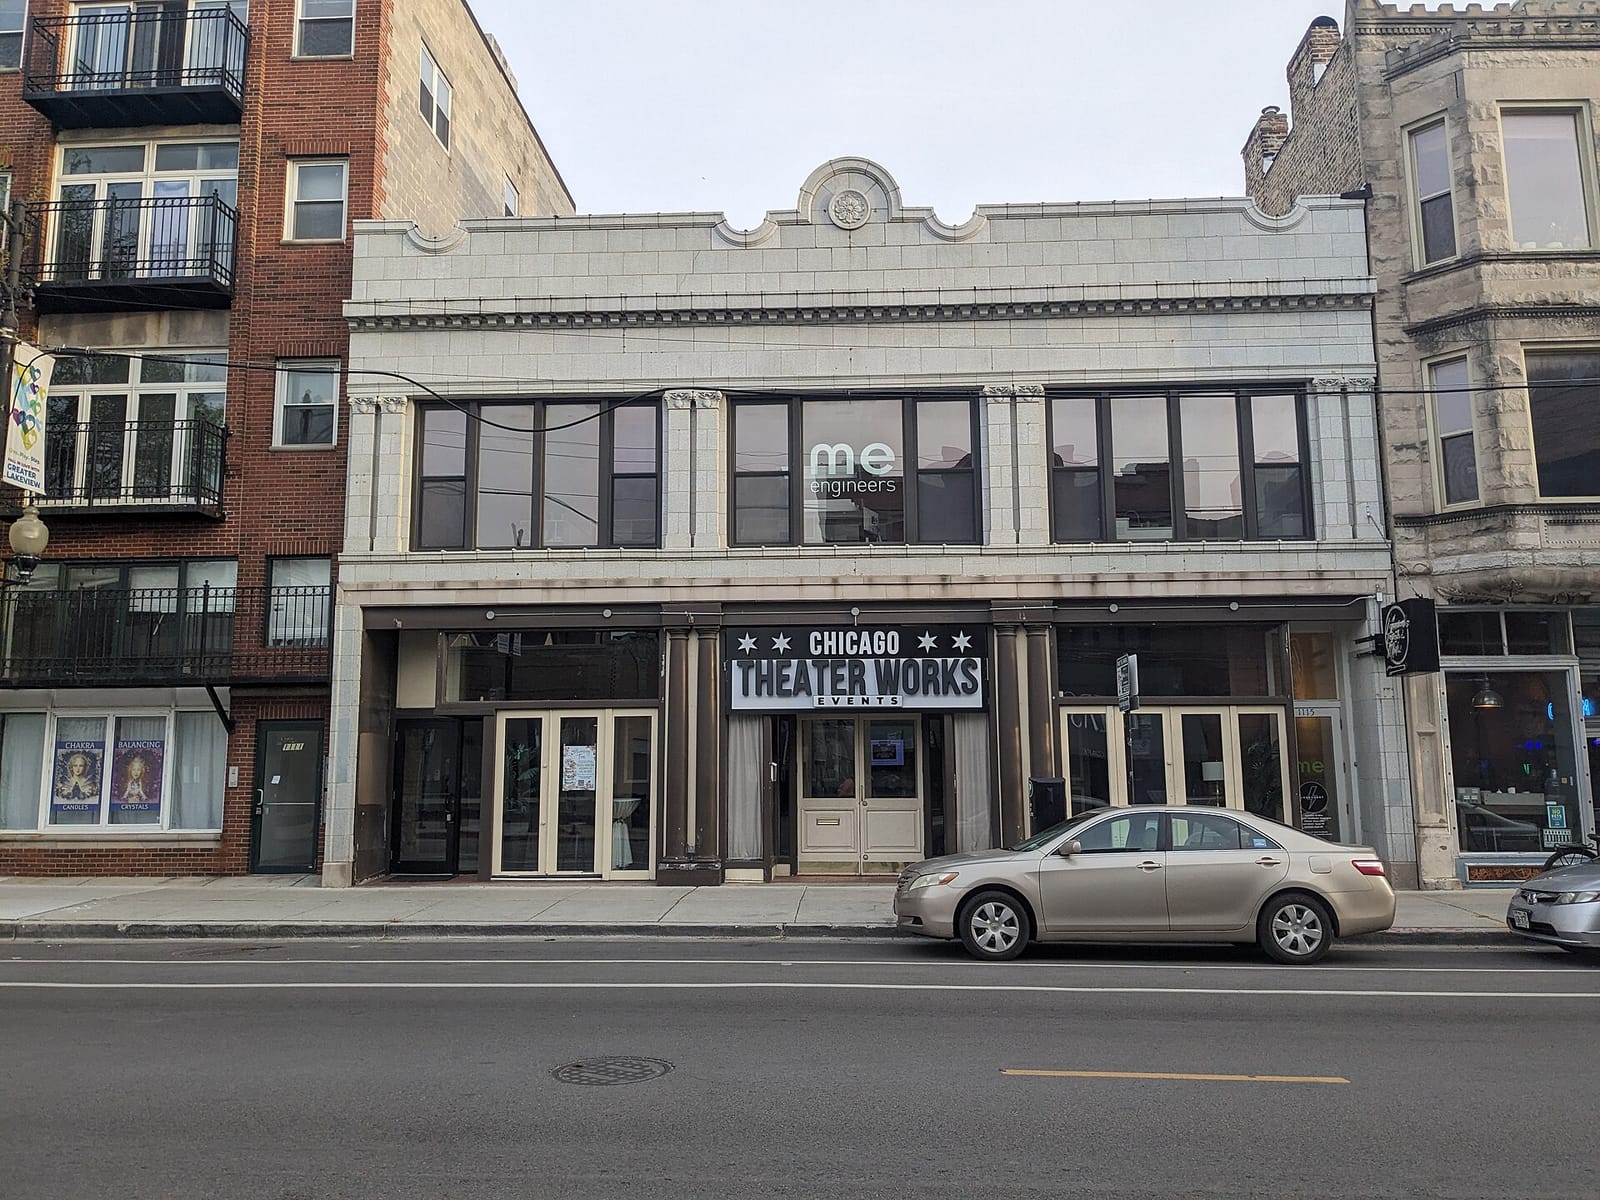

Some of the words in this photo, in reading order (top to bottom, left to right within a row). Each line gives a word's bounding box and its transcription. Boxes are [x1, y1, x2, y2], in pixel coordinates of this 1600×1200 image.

[810, 442, 896, 475] me
[7, 463, 37, 479] GREATER
[6, 471, 41, 488] LAKEVIEW
[810, 478, 896, 497] engineers
[809, 630, 900, 655] CHICAGO
[736, 660, 867, 696] THEATER
[874, 658, 979, 696] WORKS
[817, 696, 899, 706] EVENTS
[65, 741, 96, 750] CHAKRA
[117, 740, 161, 749] BALANCING
[120, 803, 149, 811] CRYSTALS
